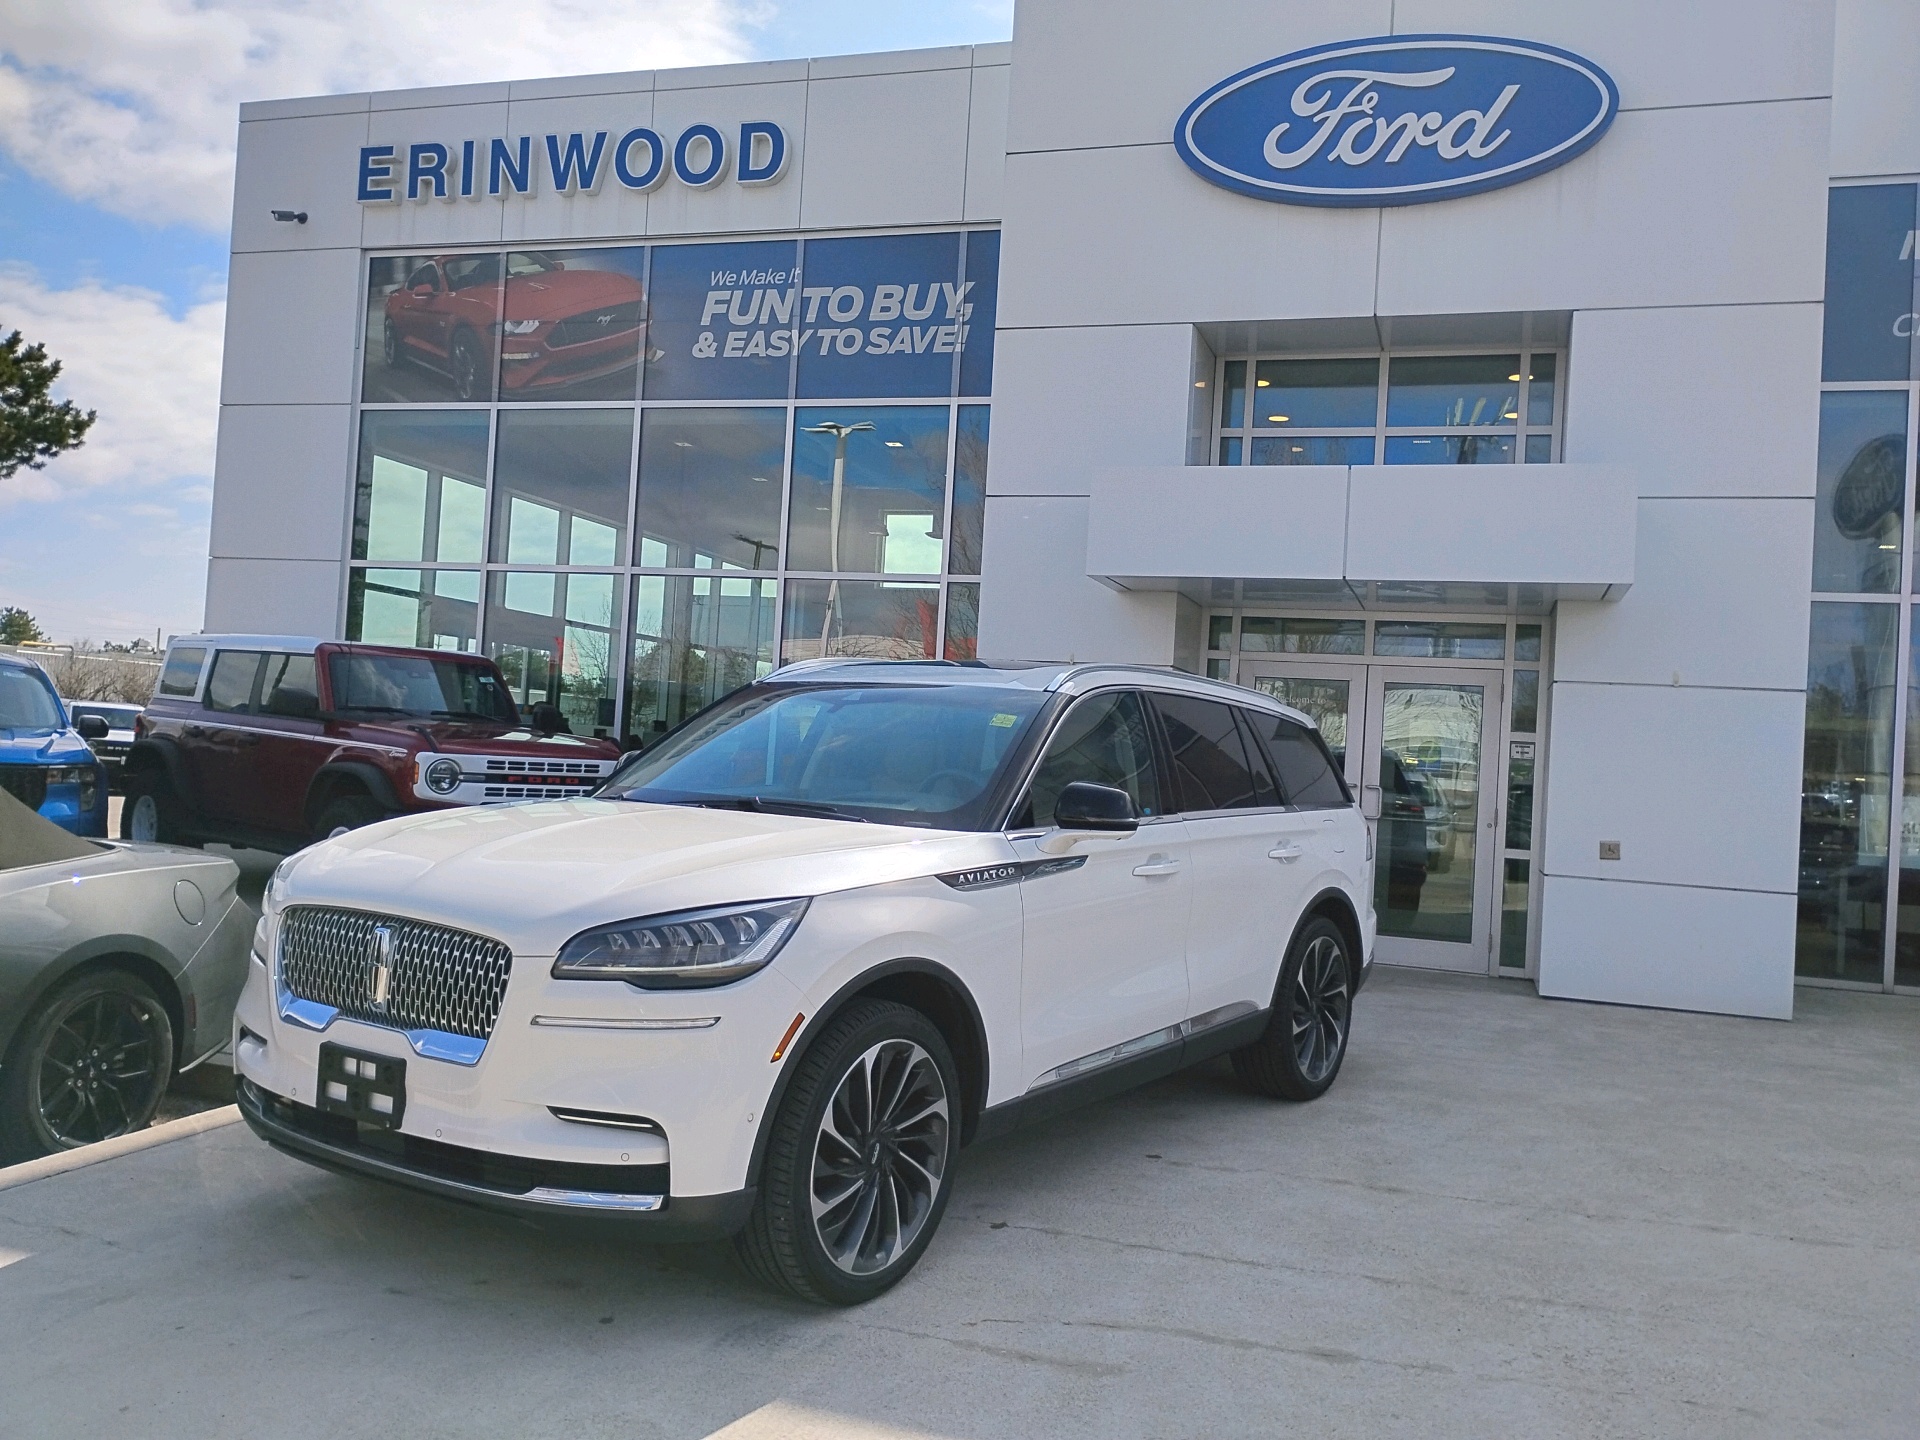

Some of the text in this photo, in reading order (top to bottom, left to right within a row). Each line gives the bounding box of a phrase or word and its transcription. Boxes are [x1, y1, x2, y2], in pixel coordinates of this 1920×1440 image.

[1263, 66, 1521, 169] Ford
[357, 120, 788, 203] ERINWOOD
[710, 266, 801, 287] We Make It
[700, 282, 976, 326] FUN TO BUY,
[692, 324, 971, 359] & EASY TO SAVE!
[507, 775, 579, 785] FORD
[958, 867, 1016, 885] AVIATOR
